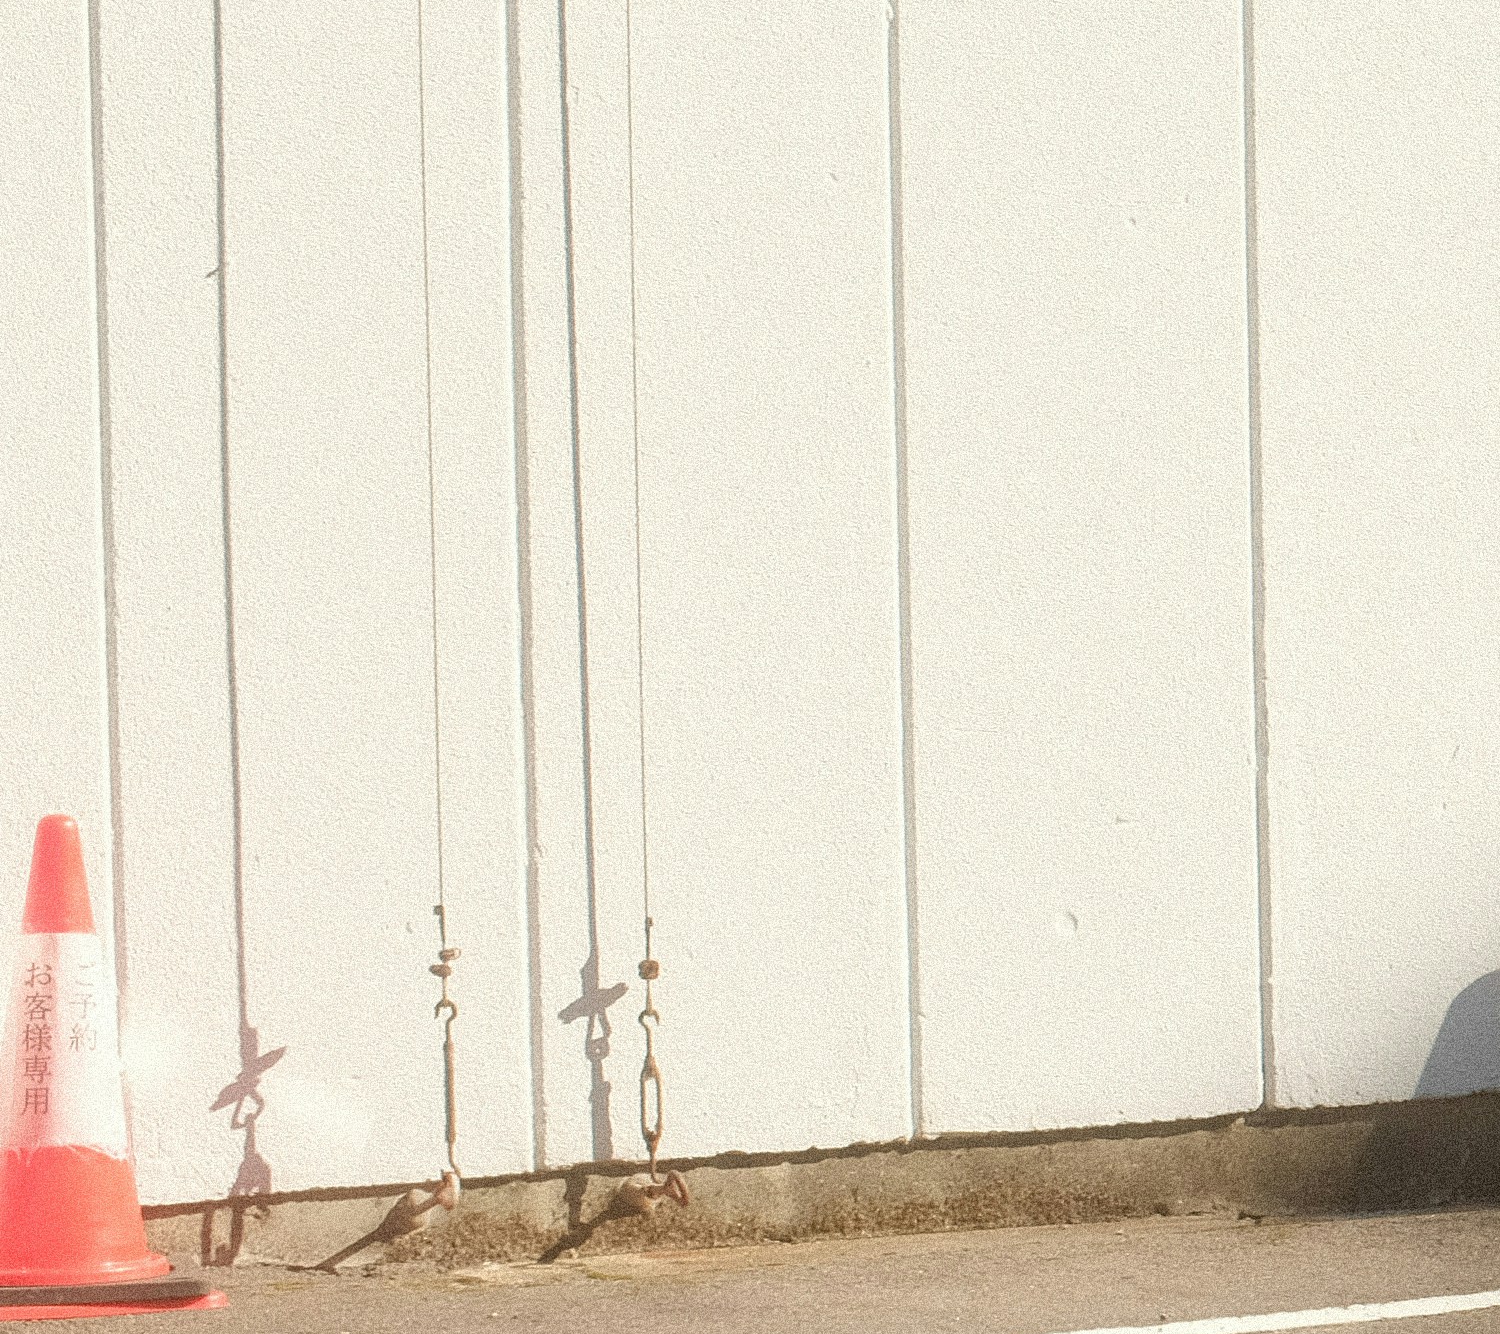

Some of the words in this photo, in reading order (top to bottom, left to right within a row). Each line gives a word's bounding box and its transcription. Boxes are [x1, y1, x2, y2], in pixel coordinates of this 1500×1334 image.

[21, 962, 53, 1116] お客様専用
[68, 961, 98, 1053] ご予約
